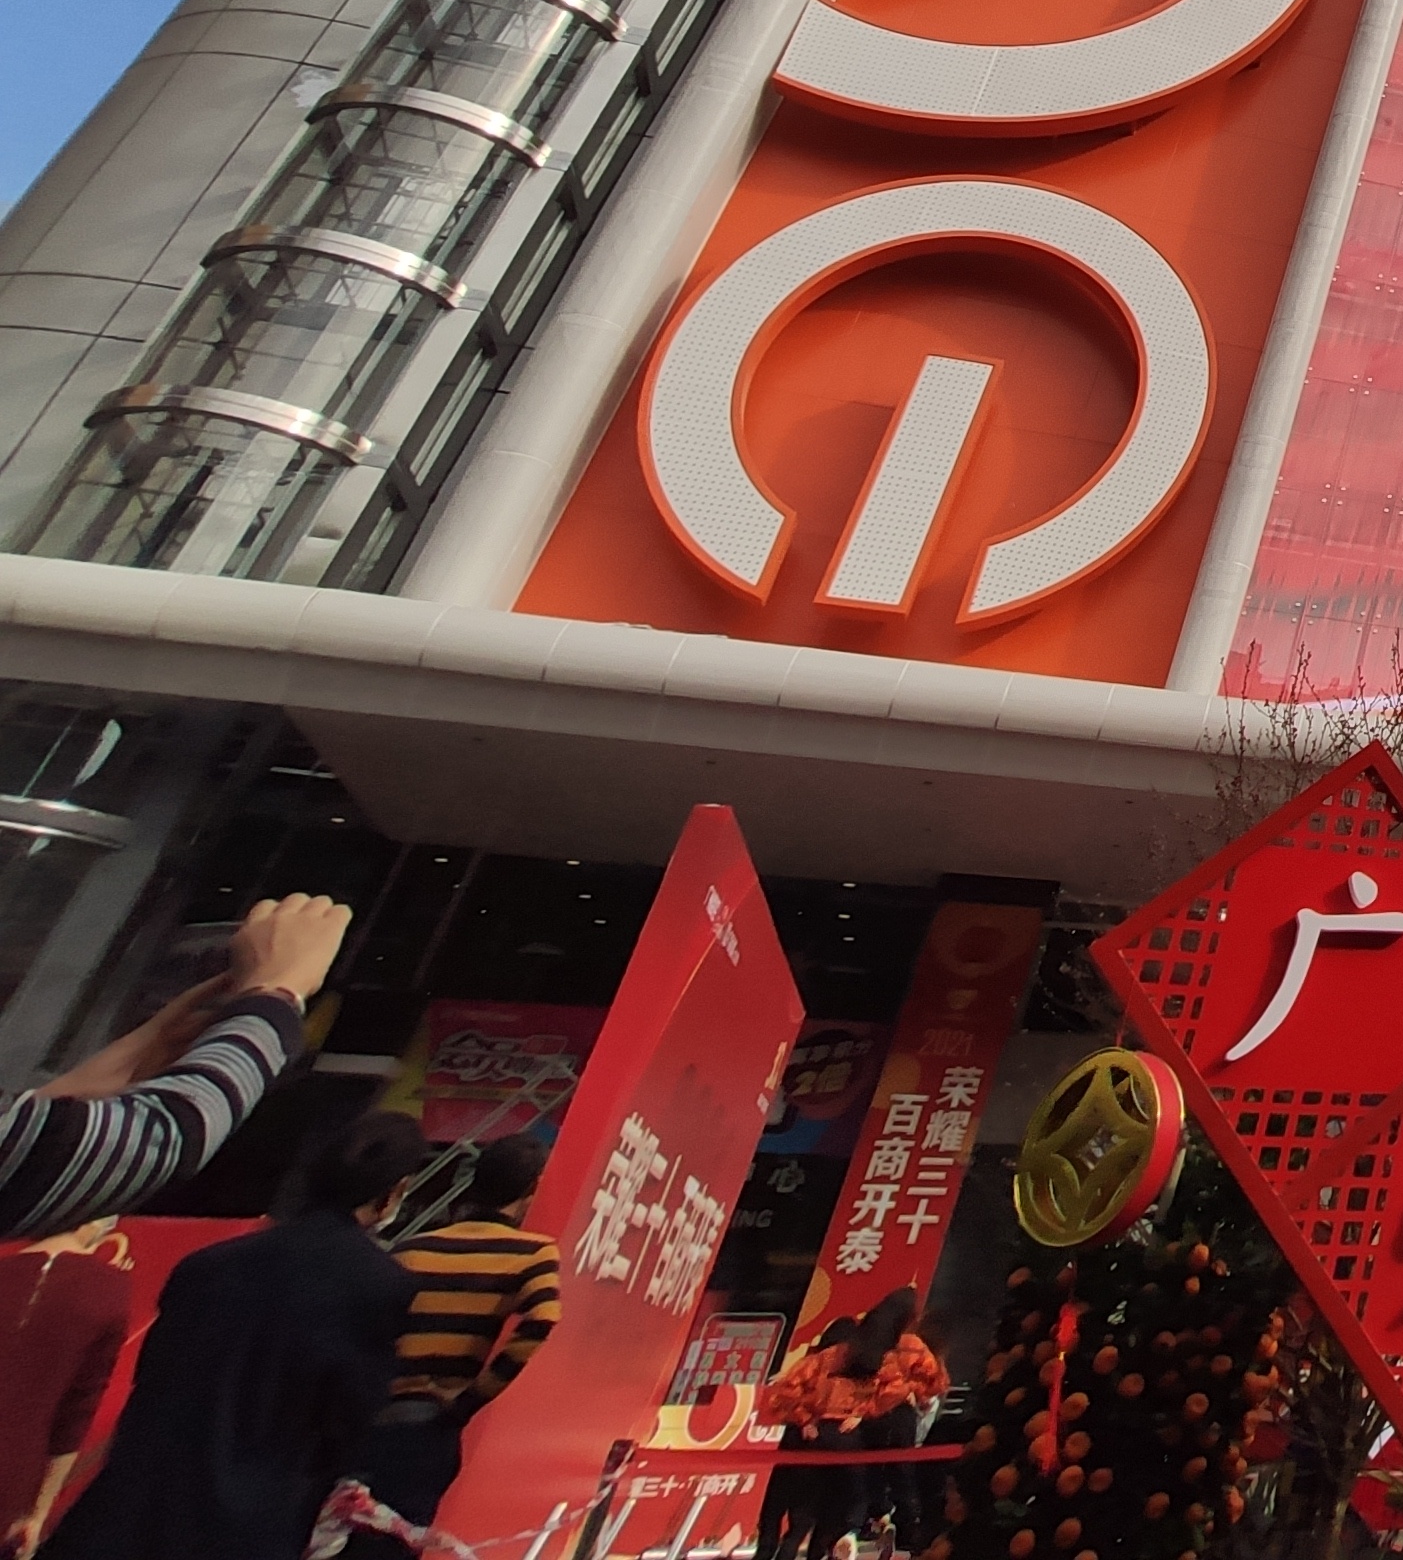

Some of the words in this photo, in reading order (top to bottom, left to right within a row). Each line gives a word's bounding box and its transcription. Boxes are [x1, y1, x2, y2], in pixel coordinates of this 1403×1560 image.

[836, 1093, 929, 1274] 百商开泰
[896, 1066, 985, 1245] 荣耀三十
